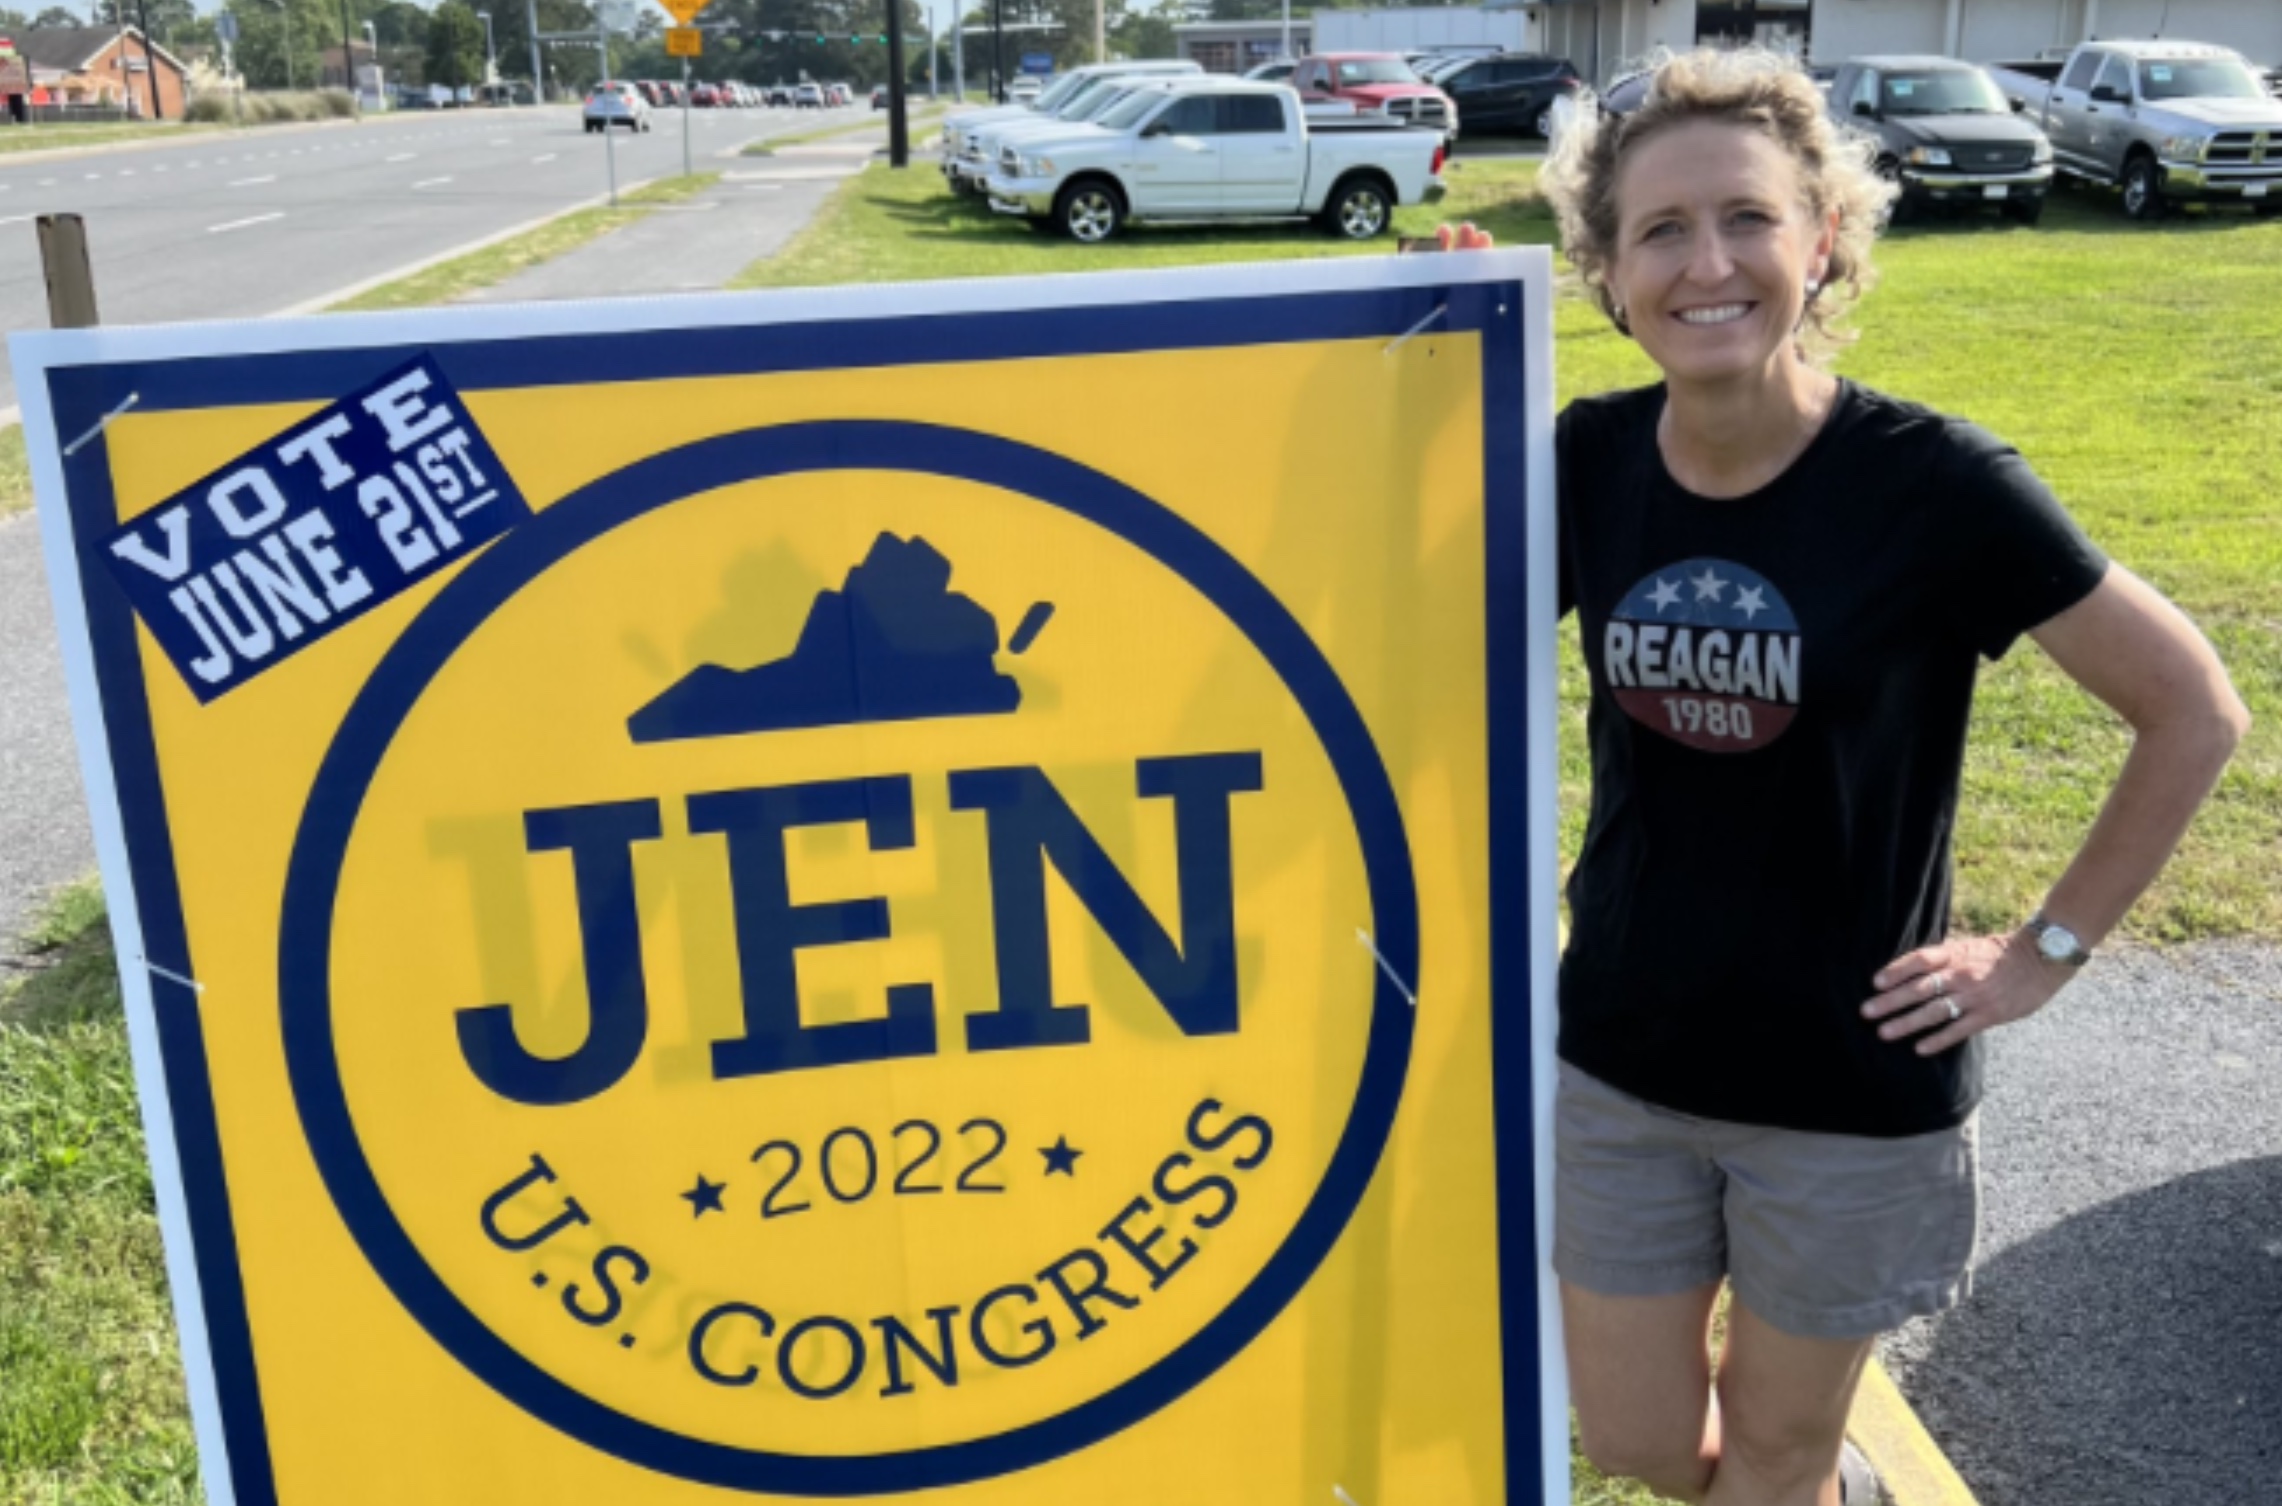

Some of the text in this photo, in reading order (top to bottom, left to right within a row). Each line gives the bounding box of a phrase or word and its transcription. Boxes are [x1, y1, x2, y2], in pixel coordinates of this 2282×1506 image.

[111, 367, 453, 581] VOTE
[168, 427, 499, 683] JUNE 21ST
[1604, 621, 1801, 703] REAGAN
[1661, 697, 1753, 739] 1980
[454, 750, 1263, 1106] JEN
[479, 1097, 1274, 1399] U.S. CONGRESS
[749, 1117, 1009, 1219] 2022
